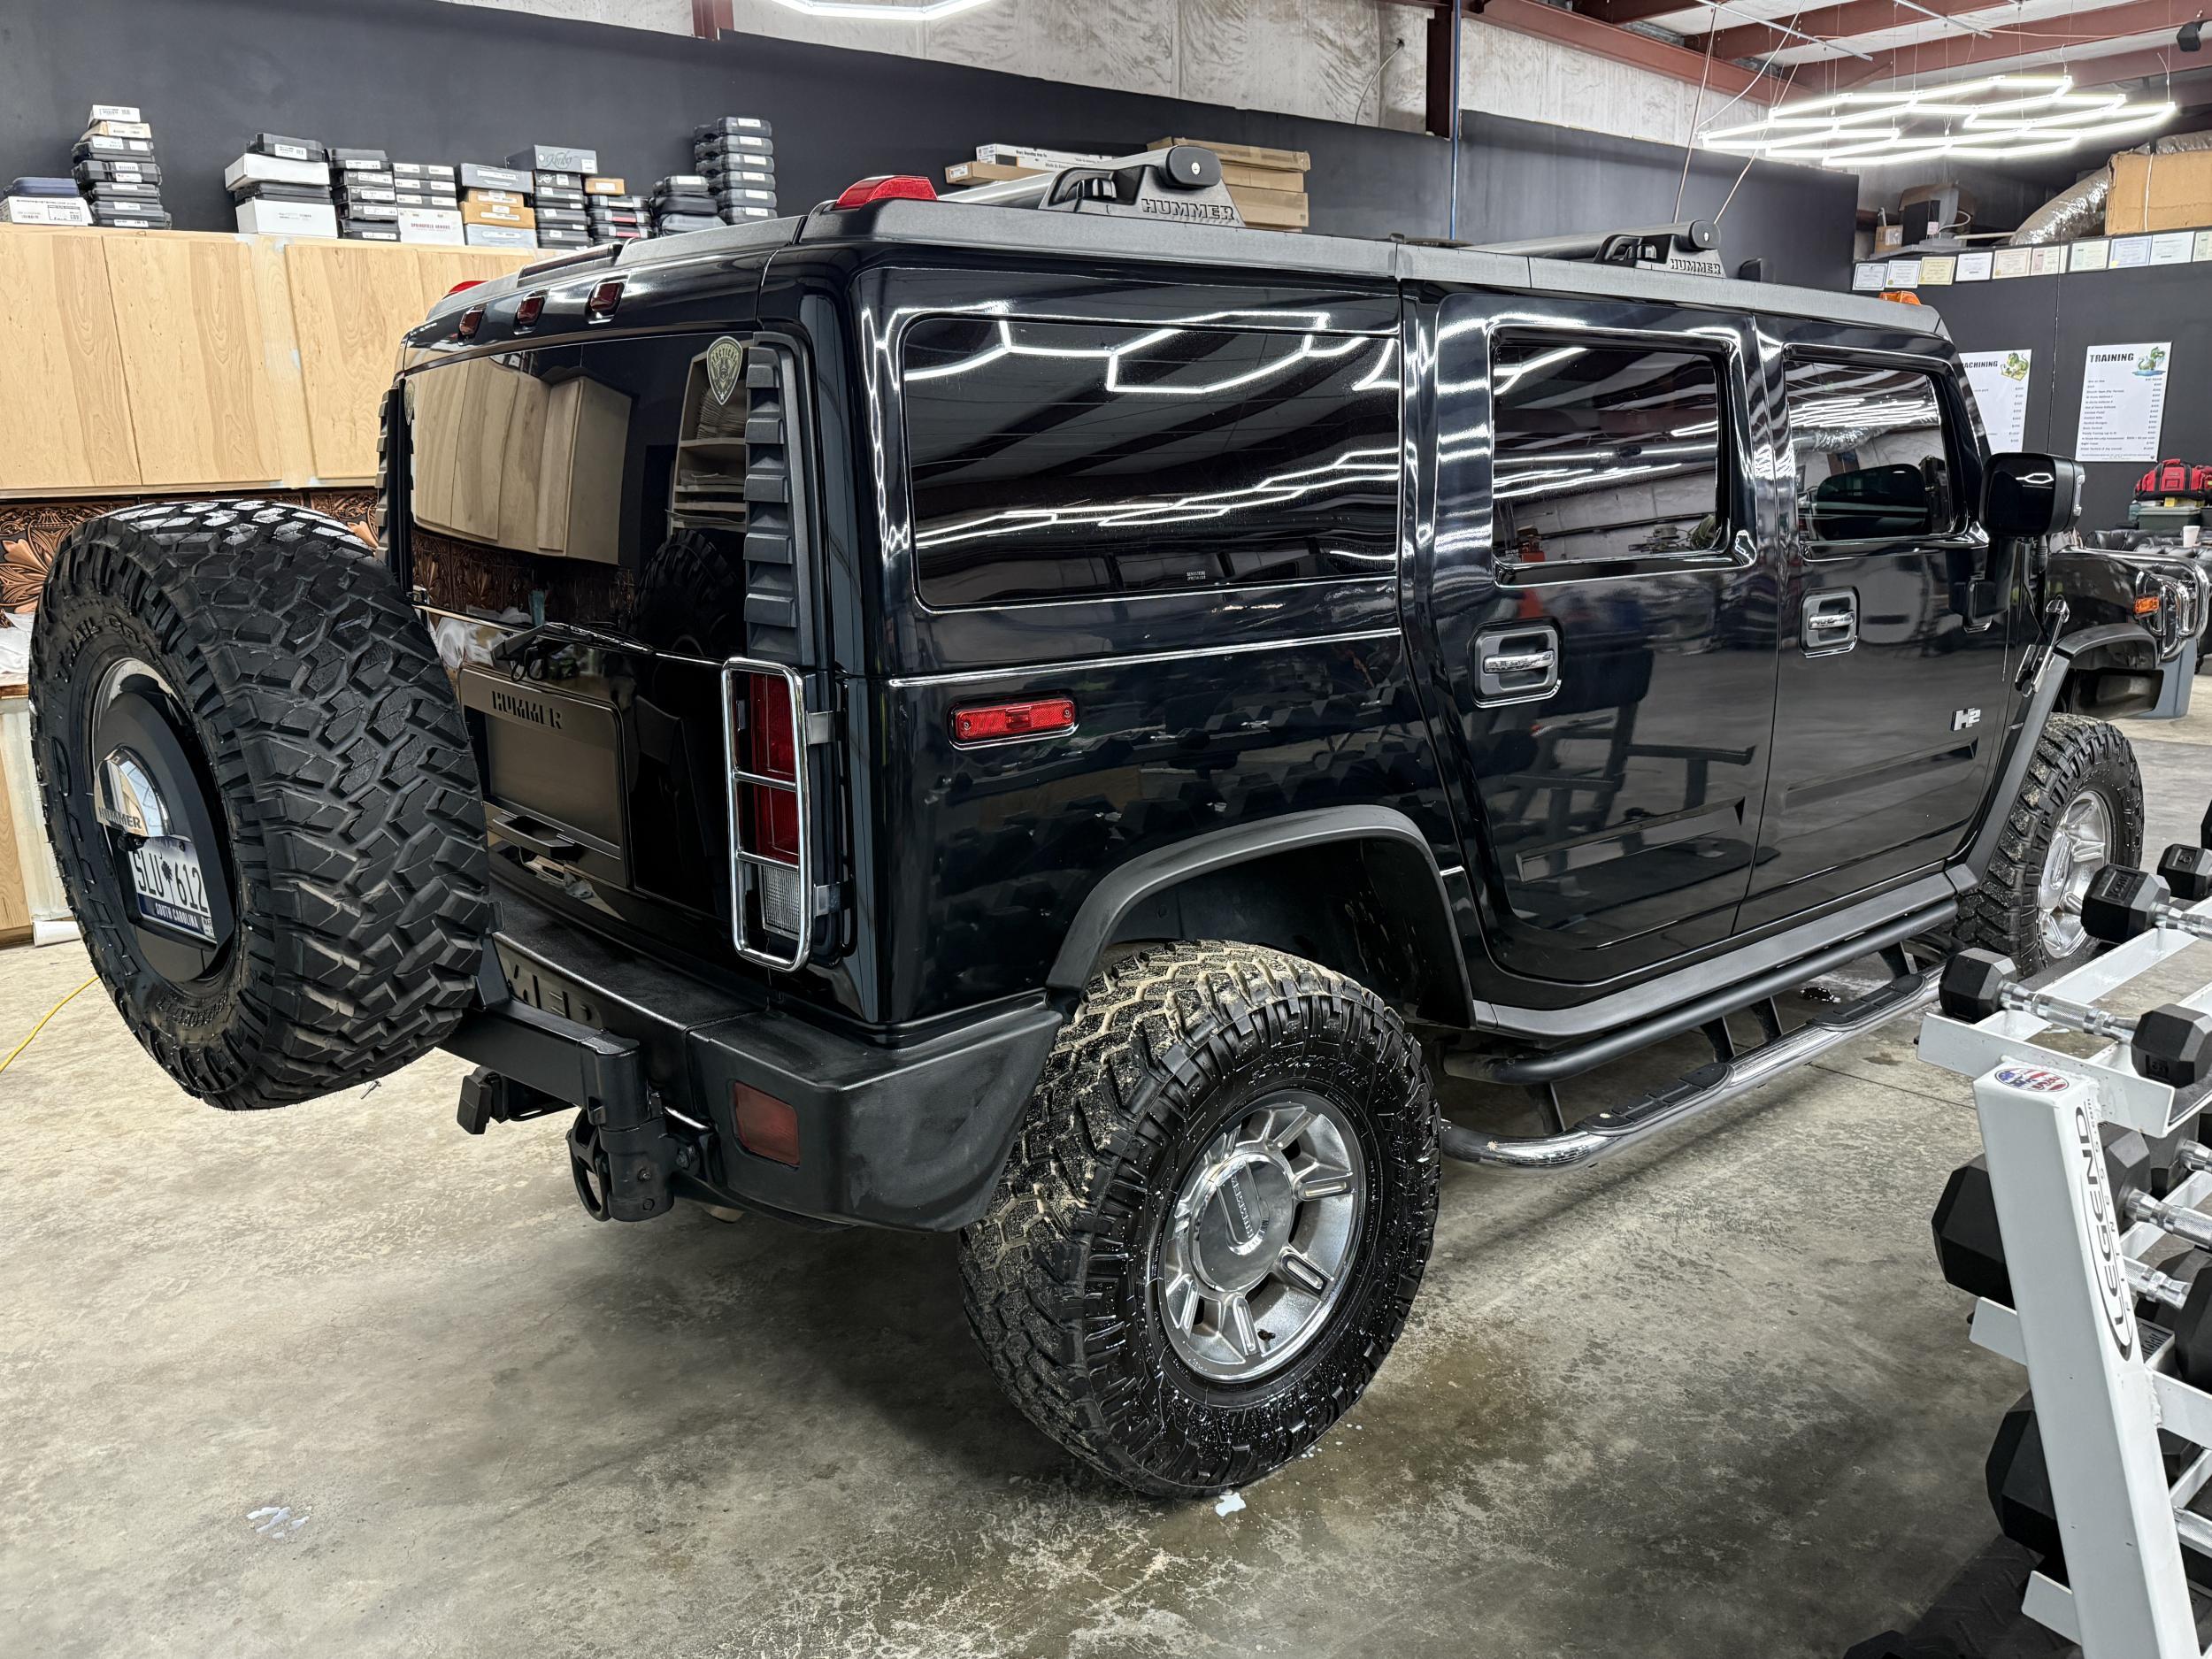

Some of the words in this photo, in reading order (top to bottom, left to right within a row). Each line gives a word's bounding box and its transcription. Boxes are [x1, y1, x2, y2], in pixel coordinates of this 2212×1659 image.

[1141, 198, 1235, 220] HUMMER
[1670, 257, 1722, 276] HUMMER
[1962, 360, 1999, 369] ACHINING
[2089, 352, 2135, 363] TRAINING
[1950, 707, 1982, 732] H2
[97, 806, 142, 830] HUMMER
[131, 850, 165, 898] SLU
[173, 863, 210, 914] 612
[155, 902, 173, 920] SOUTH
[173, 909, 199, 929] CAROLINA
[1230, 1175, 1255, 1239] HUMMER
[2075, 1106, 2125, 1327] LEGEND
